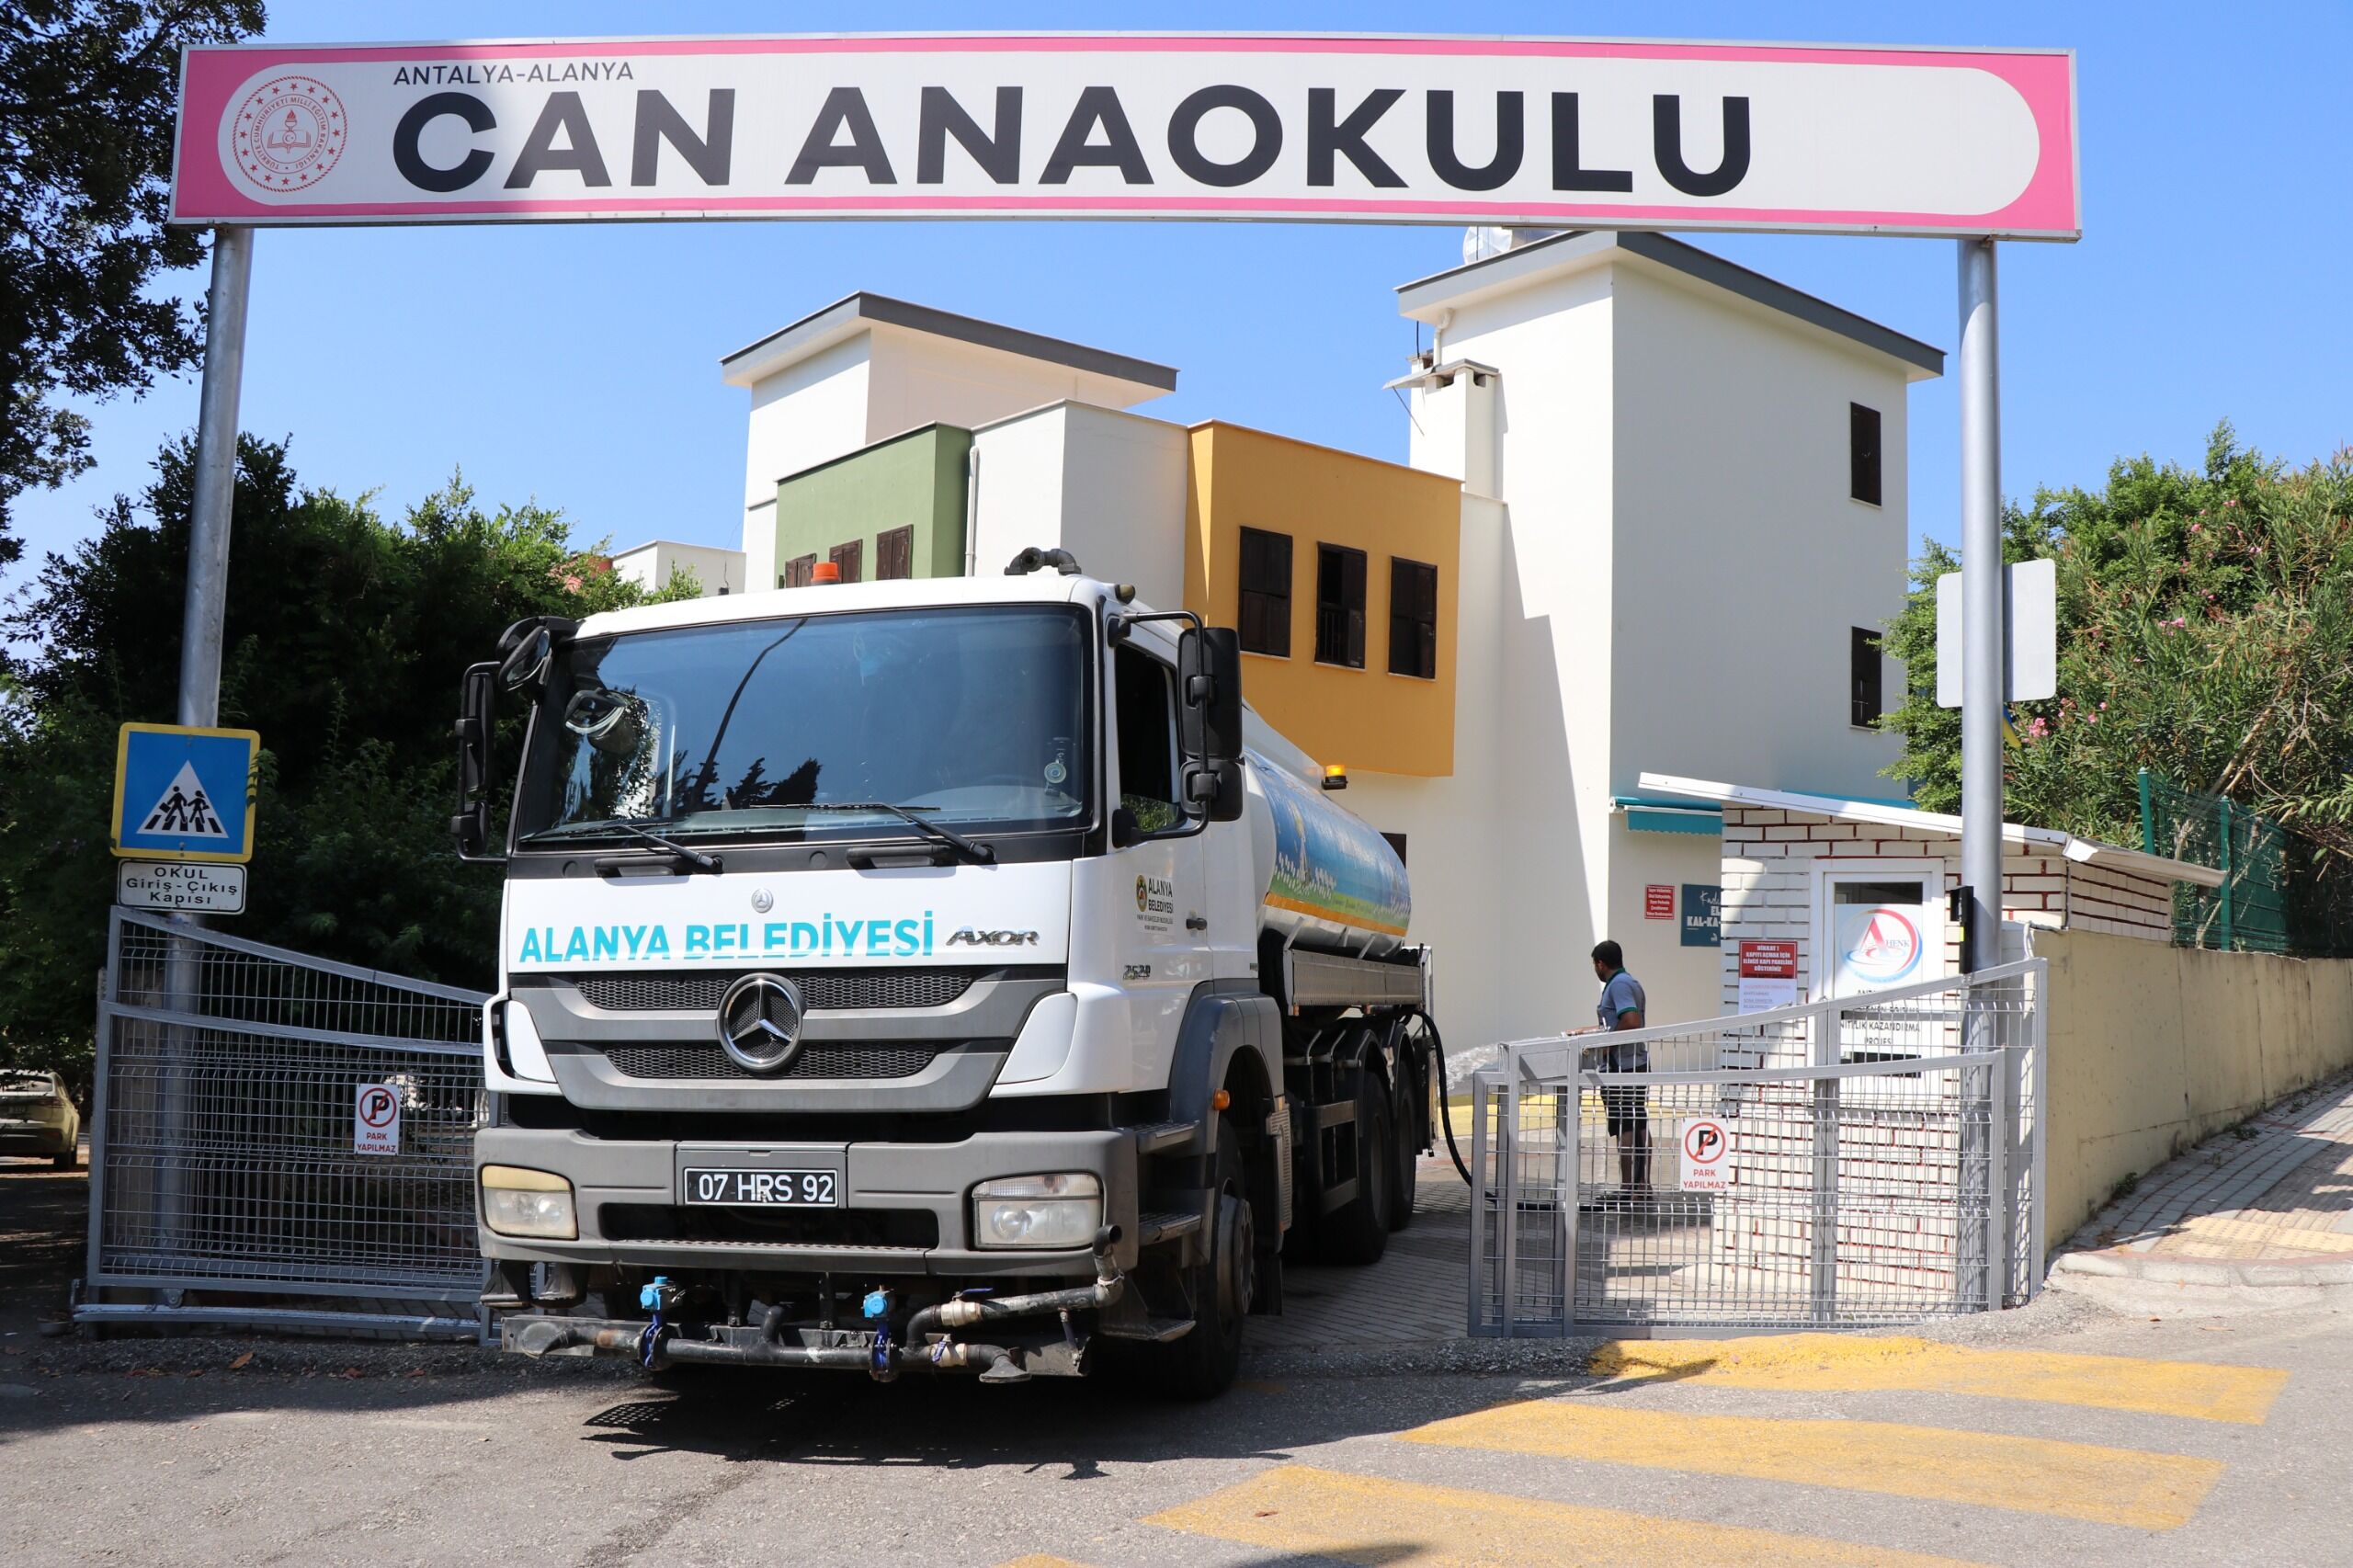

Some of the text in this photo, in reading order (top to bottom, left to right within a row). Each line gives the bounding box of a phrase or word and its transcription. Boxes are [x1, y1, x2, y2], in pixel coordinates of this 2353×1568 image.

[392, 61, 634, 86] ANTALYA-ALANYA
[392, 85, 1751, 198] CAN ANAOKULU
[154, 867, 209, 880] OKUL
[1148, 878, 1173, 898] ALANYA
[150, 892, 210, 905] Kapısı
[520, 911, 934, 963] ALANYA BELEDİYESİ
[946, 926, 1040, 947] AXOR
[366, 1131, 388, 1141] PARK
[357, 1143, 396, 1153] YAPILMAZ
[1693, 1168, 1717, 1177] PARK
[699, 1174, 834, 1202] 07 HRS 92
[1683, 1180, 1726, 1189] YAPILMAZ
